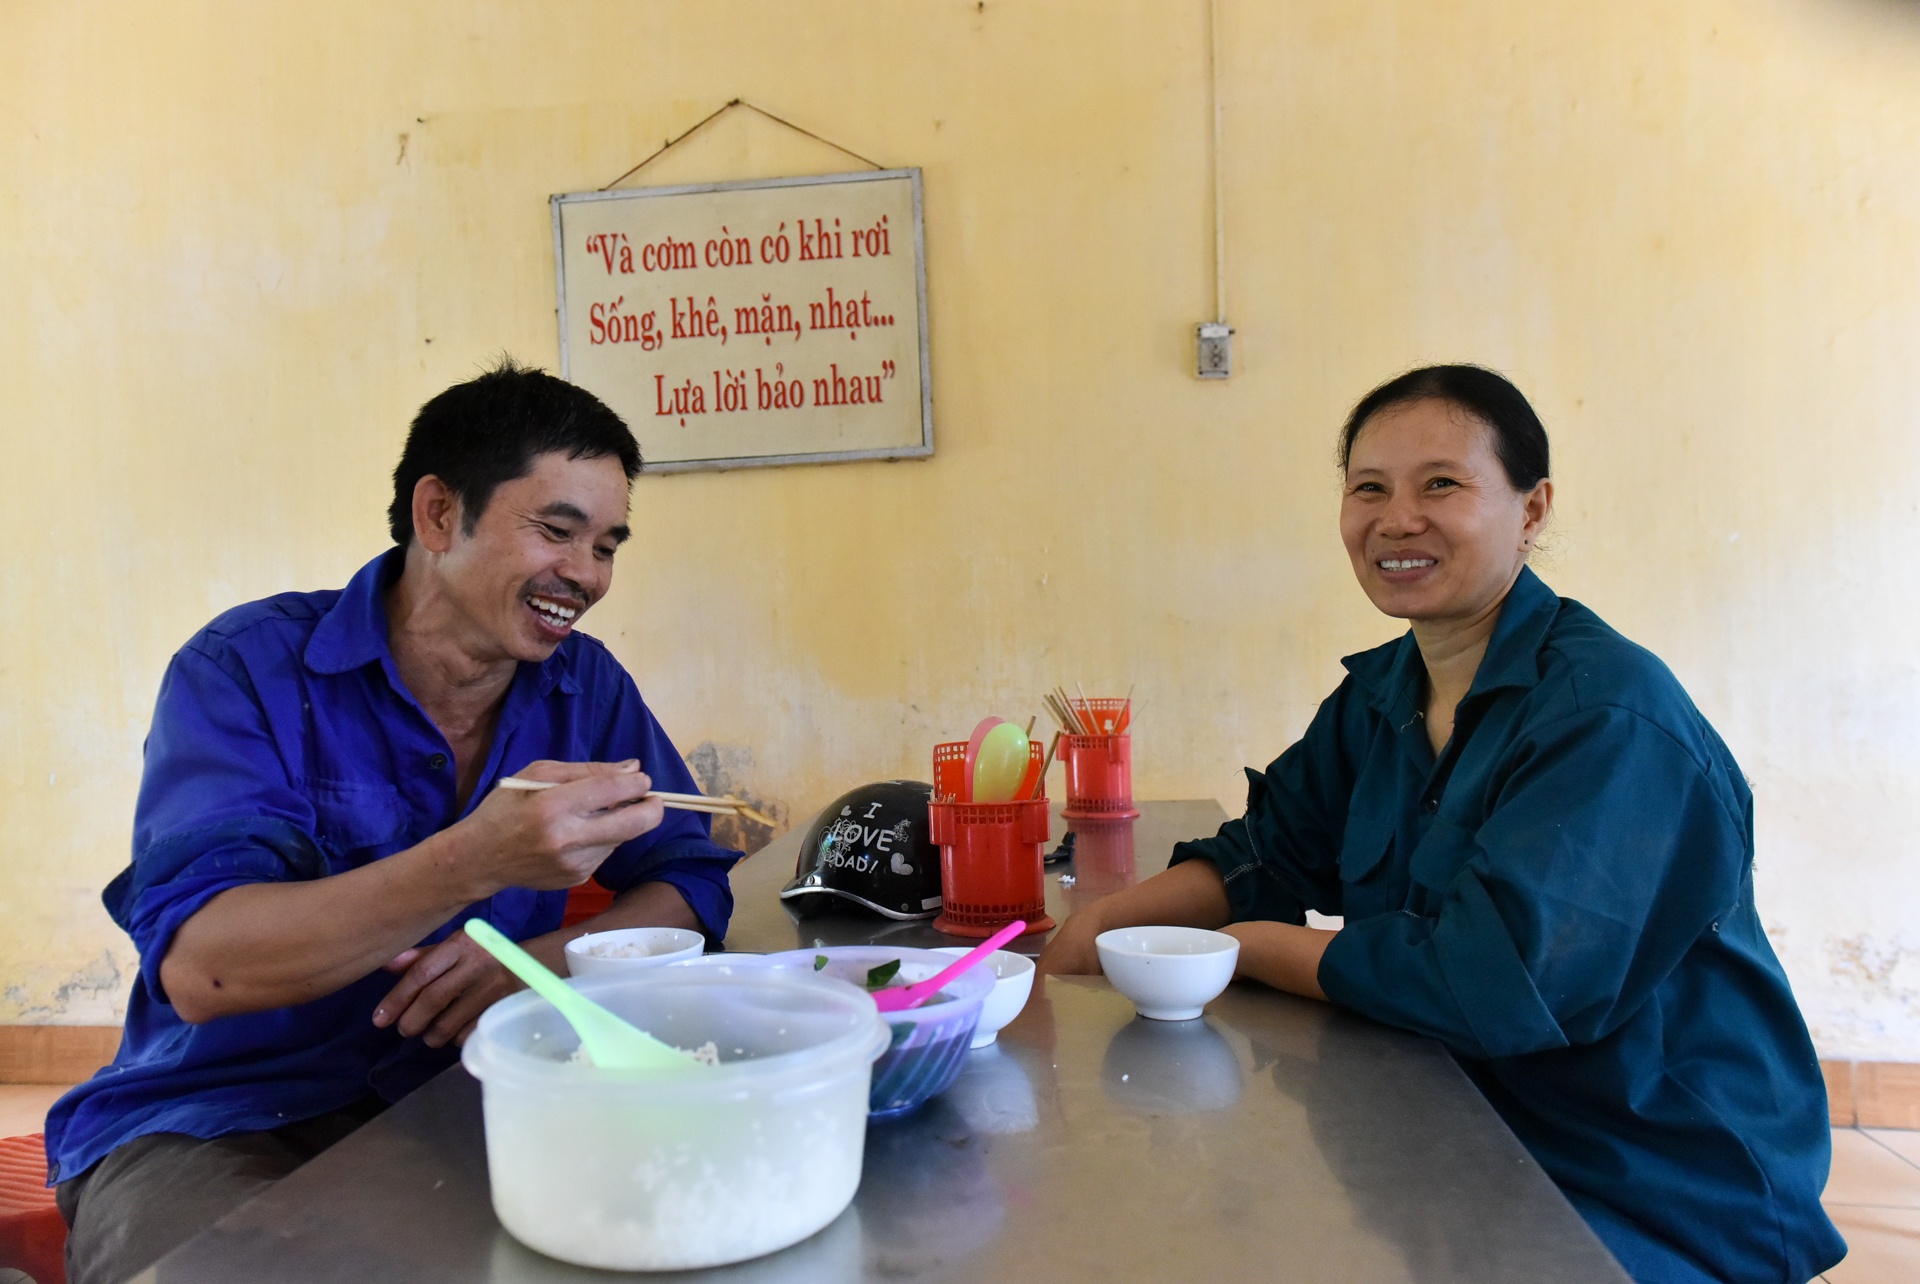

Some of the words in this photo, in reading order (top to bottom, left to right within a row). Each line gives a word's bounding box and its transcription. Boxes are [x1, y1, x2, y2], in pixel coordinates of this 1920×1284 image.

[642, 236, 697, 272] cơm
[705, 227, 752, 267] còn
[760, 223, 790, 264] có
[798, 218, 843, 261] khi
[852, 215, 890, 257] rơi
[590, 296, 663, 350] Sống,
[670, 296, 727, 344] khê,
[734, 294, 802, 346] mặn,
[654, 373, 707, 427] Lựa
[714, 370, 748, 412] lời
[756, 362, 805, 409] bảo
[863, 802, 882, 819] I
[832, 822, 896, 852] LOVE
[834, 854, 878, 874] DAD!
